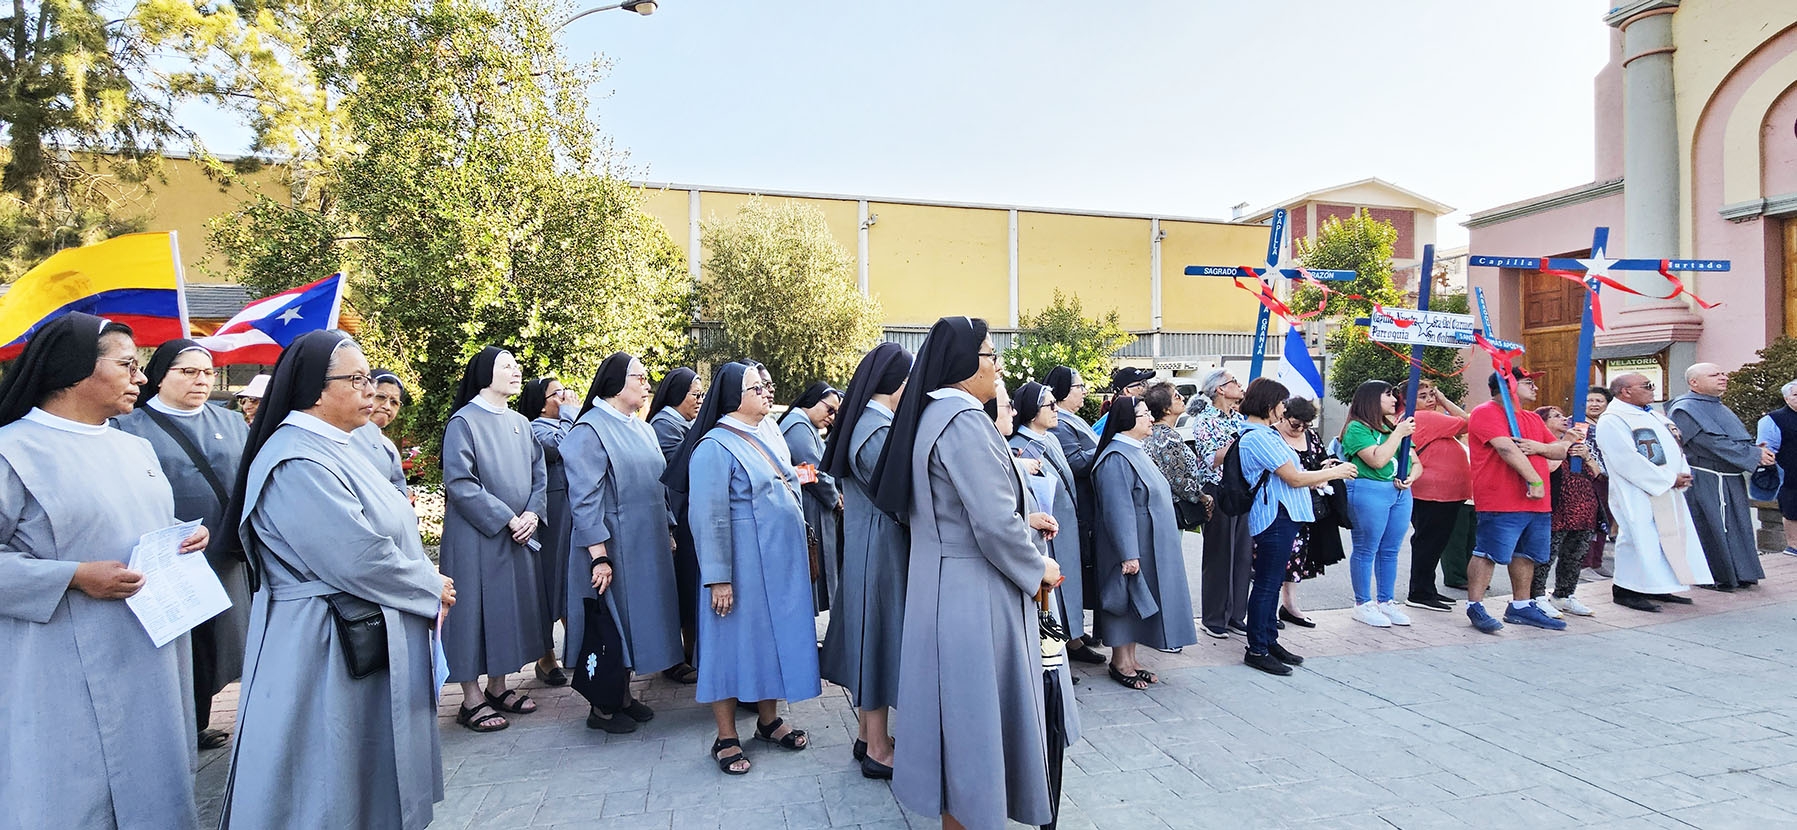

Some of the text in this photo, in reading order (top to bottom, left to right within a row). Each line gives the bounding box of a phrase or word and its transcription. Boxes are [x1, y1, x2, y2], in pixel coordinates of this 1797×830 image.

[1272, 211, 1283, 255] CAPILLA
[1478, 257, 1533, 267] Capilla
[1203, 267, 1237, 276] SAGRADO
[1256, 318, 1268, 355] GRANJA
[1372, 325, 1410, 341] Parroquia
[1610, 357, 1658, 367] VELATORIO
